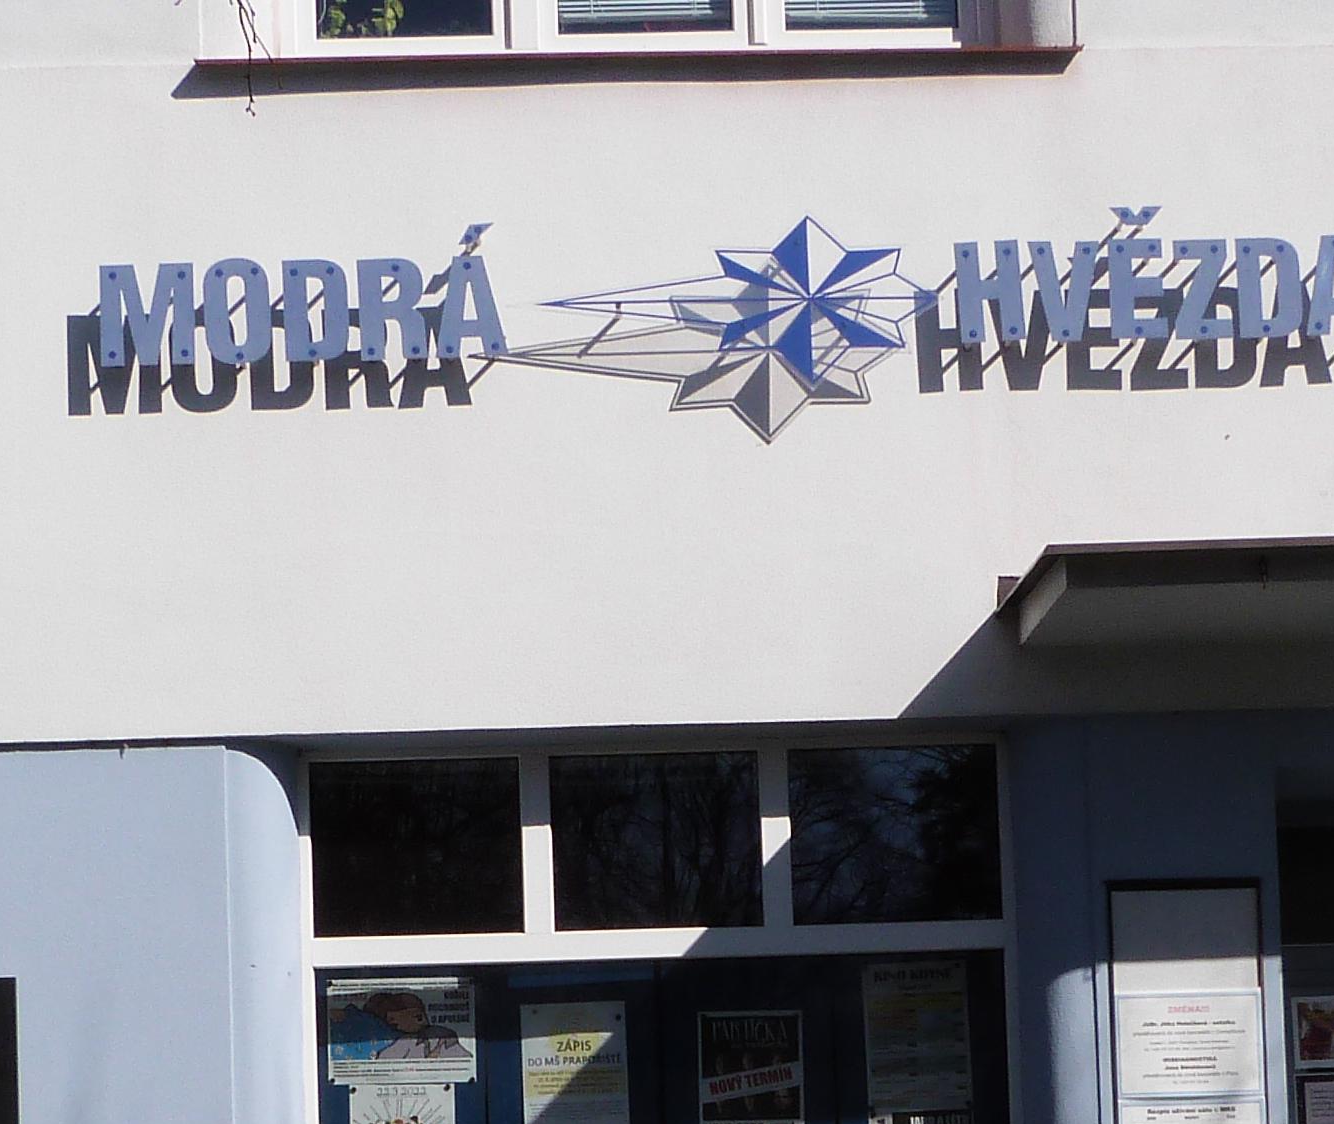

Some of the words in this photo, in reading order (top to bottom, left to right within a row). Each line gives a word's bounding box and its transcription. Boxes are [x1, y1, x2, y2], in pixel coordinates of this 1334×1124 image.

[99, 222, 509, 368] MODRÁ
[557, 1038, 592, 1052] ZÁPIS
[528, 1057, 543, 1067] DO
[545, 1055, 560, 1066] MŠ
[709, 1074, 742, 1095] NOVÝ
[745, 1065, 793, 1088] TERMÍN
